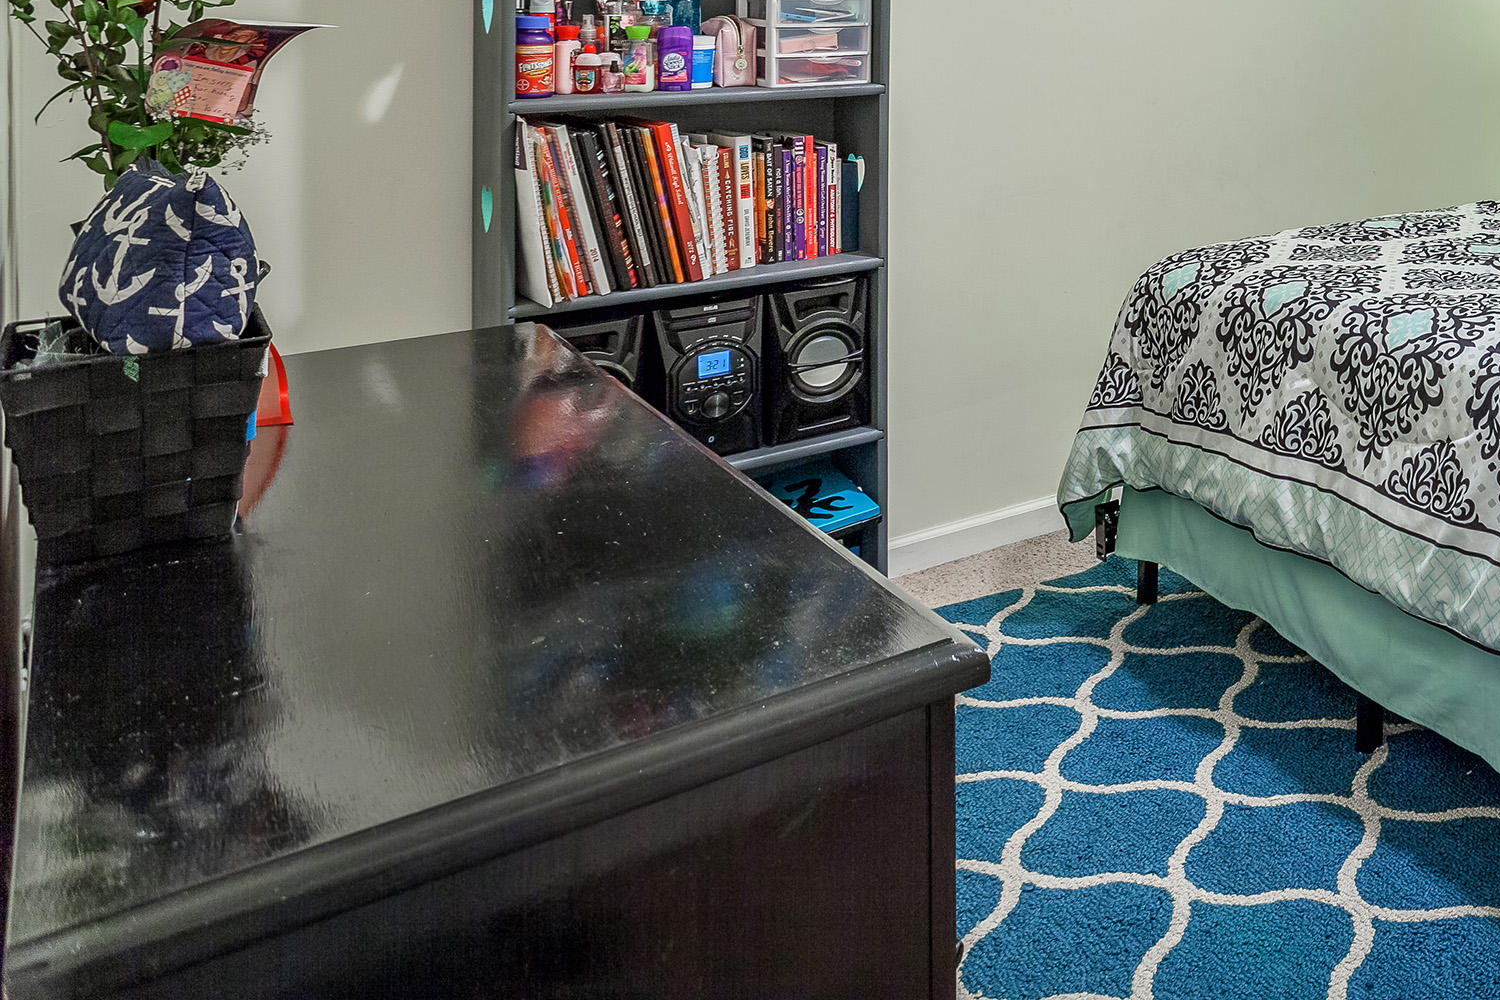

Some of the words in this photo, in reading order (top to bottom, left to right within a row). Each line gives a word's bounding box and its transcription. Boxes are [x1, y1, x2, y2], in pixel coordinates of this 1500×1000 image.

[739, 162, 750, 180] LOVES
[766, 168, 772, 176] OF
[724, 179, 733, 217] CATCHING
[727, 219, 735, 237] FIRE
[767, 230, 775, 253] Bevere
[590, 246, 599, 263] 2014
